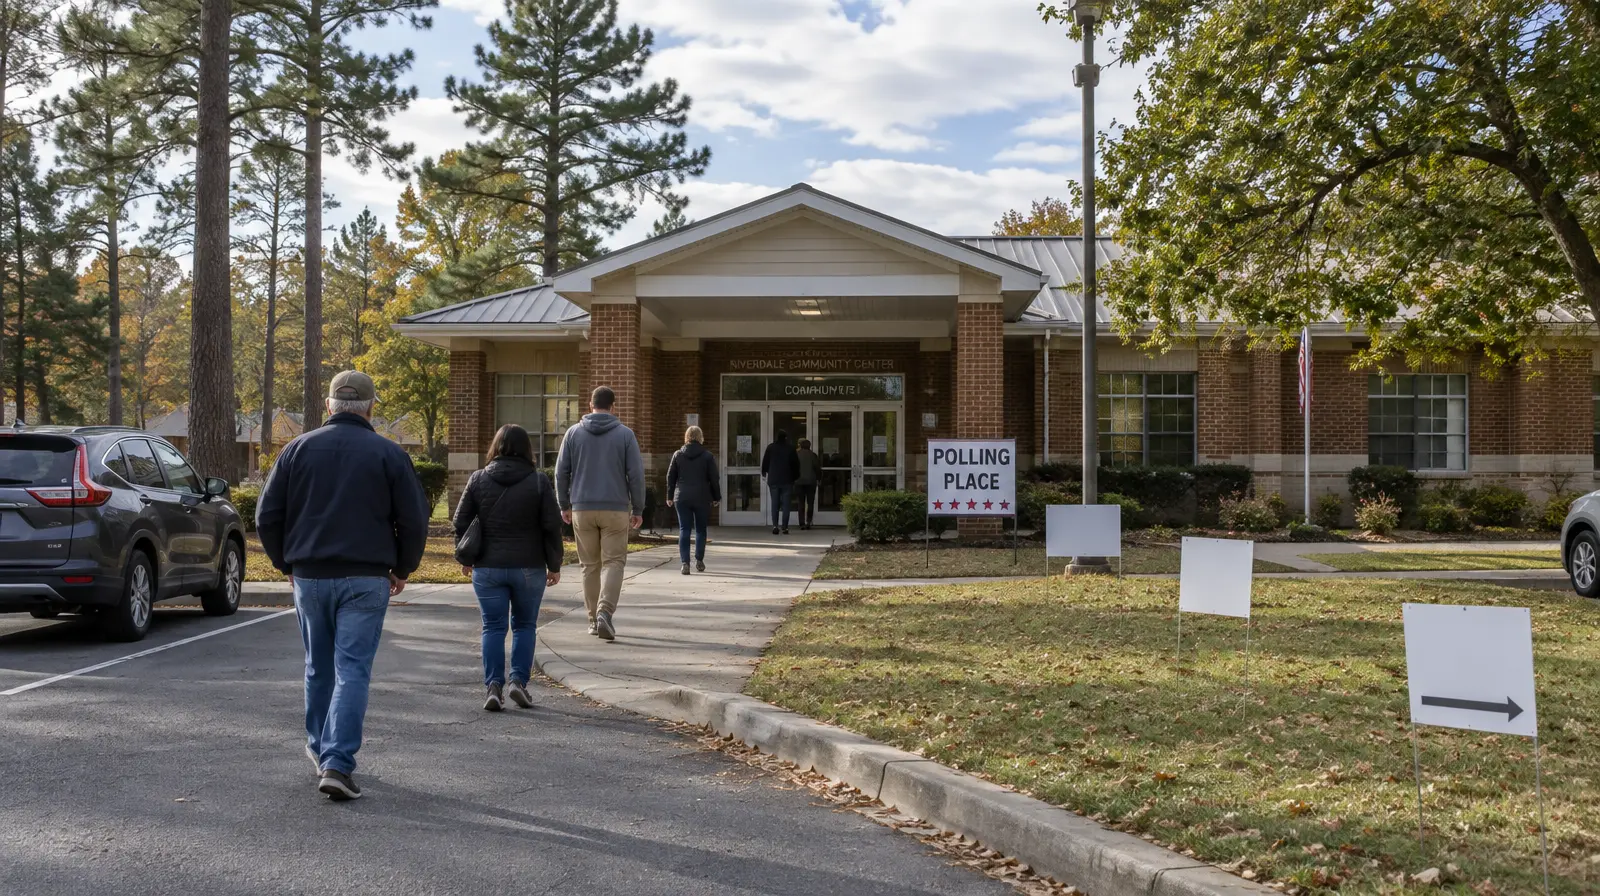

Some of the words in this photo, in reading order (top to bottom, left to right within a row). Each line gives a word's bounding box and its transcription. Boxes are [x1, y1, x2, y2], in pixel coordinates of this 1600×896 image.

[854, 359, 894, 369] CENTER
[933, 448, 1010, 466] POLLING
[944, 472, 1000, 490] PLACE
